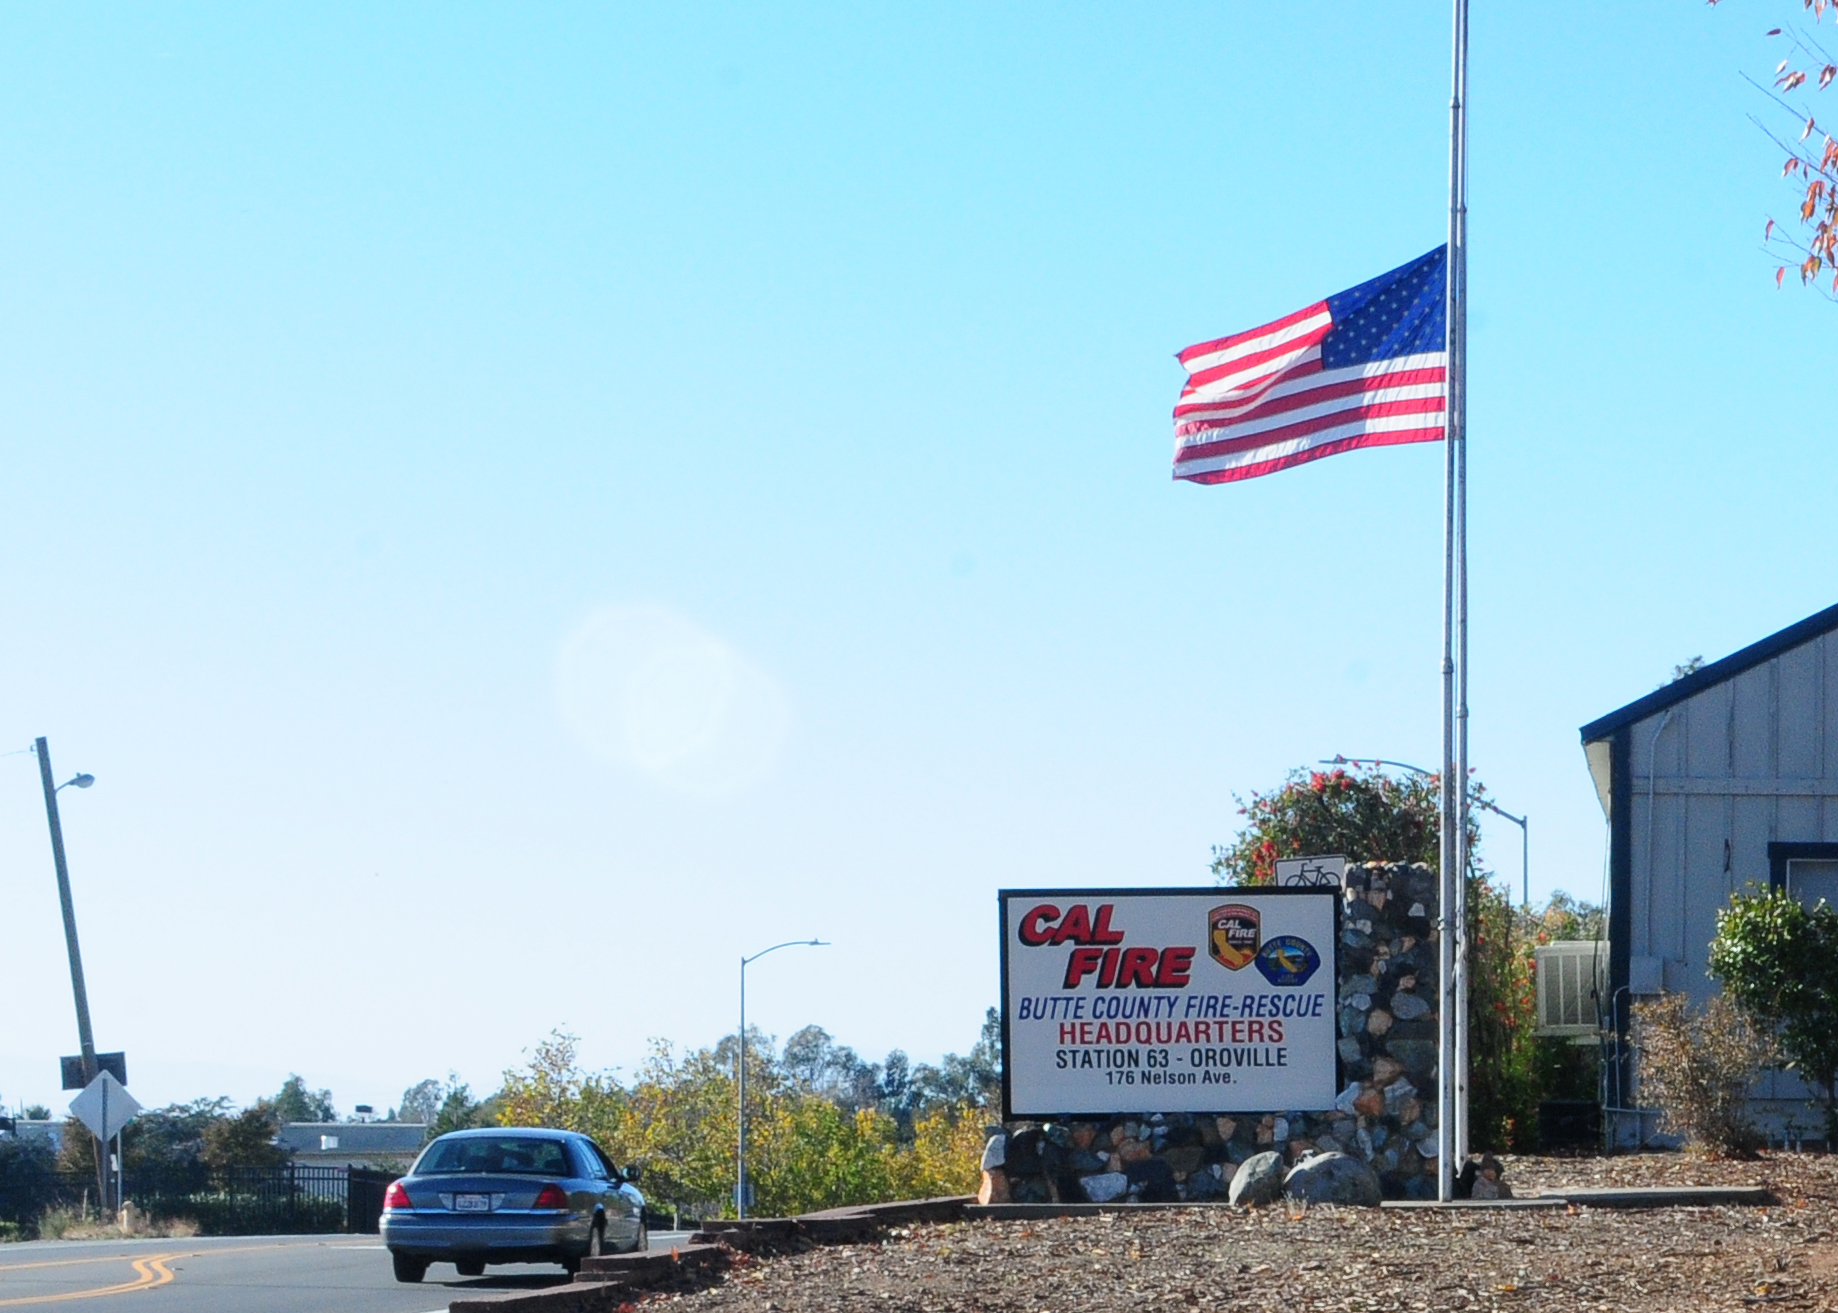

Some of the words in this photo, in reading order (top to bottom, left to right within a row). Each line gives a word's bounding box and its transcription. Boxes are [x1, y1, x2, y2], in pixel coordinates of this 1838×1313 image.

[1018, 904, 1125, 947] CAL
[1217, 919, 1241, 929] CAL
[1228, 929, 1256, 938] FIRE
[1062, 946, 1197, 990] FIRE
[1018, 996, 1087, 1020] BUTTE
[1092, 995, 1179, 1019] COUNTY
[1184, 993, 1325, 1018] FIRE-RESCUE
[1059, 1020, 1284, 1045] HEADQUARTERS
[1056, 1048, 1139, 1069] STATION
[1147, 1048, 1169, 1069] 63
[1190, 1047, 1288, 1067] OROVILLE
[1105, 1070, 1135, 1085] 176
[1141, 1070, 1196, 1085] Nelson
[1202, 1069, 1237, 1084] Ave.
